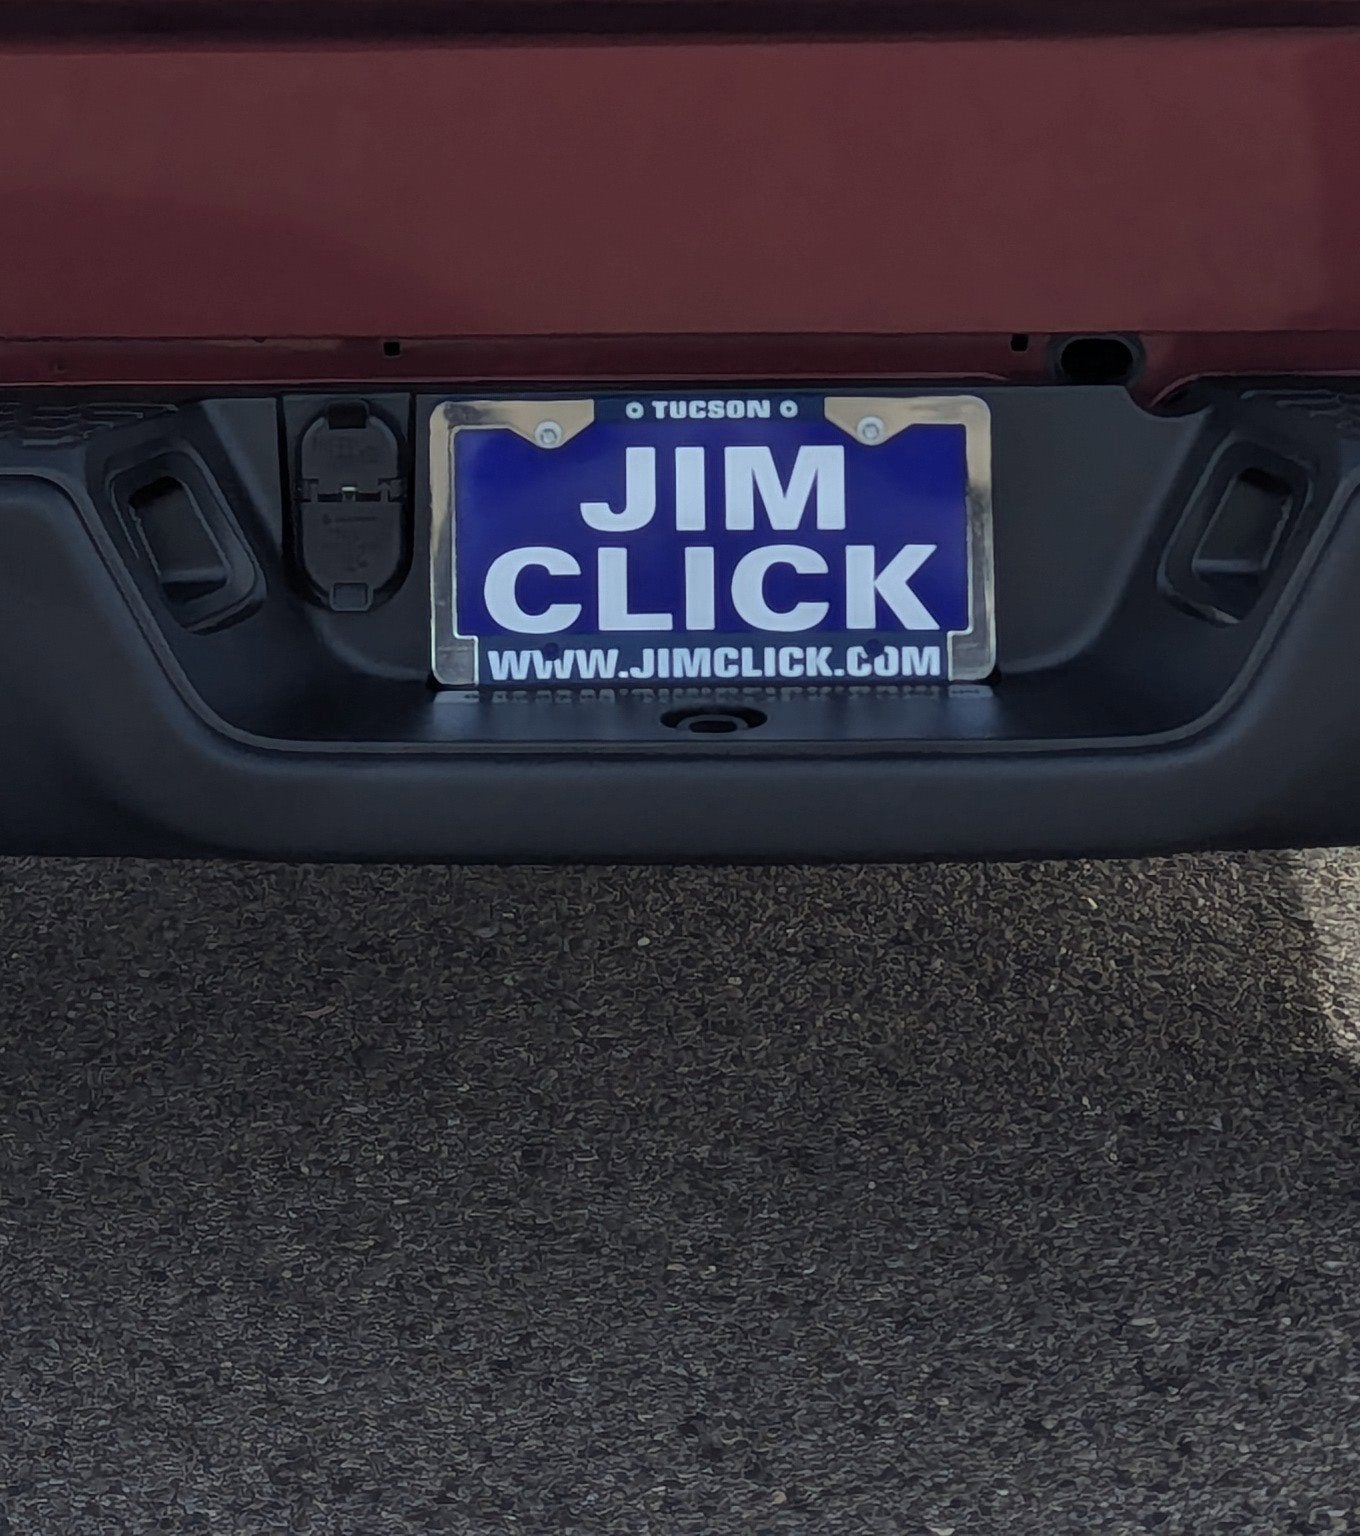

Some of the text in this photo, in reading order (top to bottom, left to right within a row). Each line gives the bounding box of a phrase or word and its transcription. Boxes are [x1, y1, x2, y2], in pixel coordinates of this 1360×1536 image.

[652, 399, 771, 419] TUCSON
[579, 444, 847, 533] JIM
[483, 544, 941, 634] CLICK
[487, 645, 942, 681] WWW.JIMCLICK.COM
